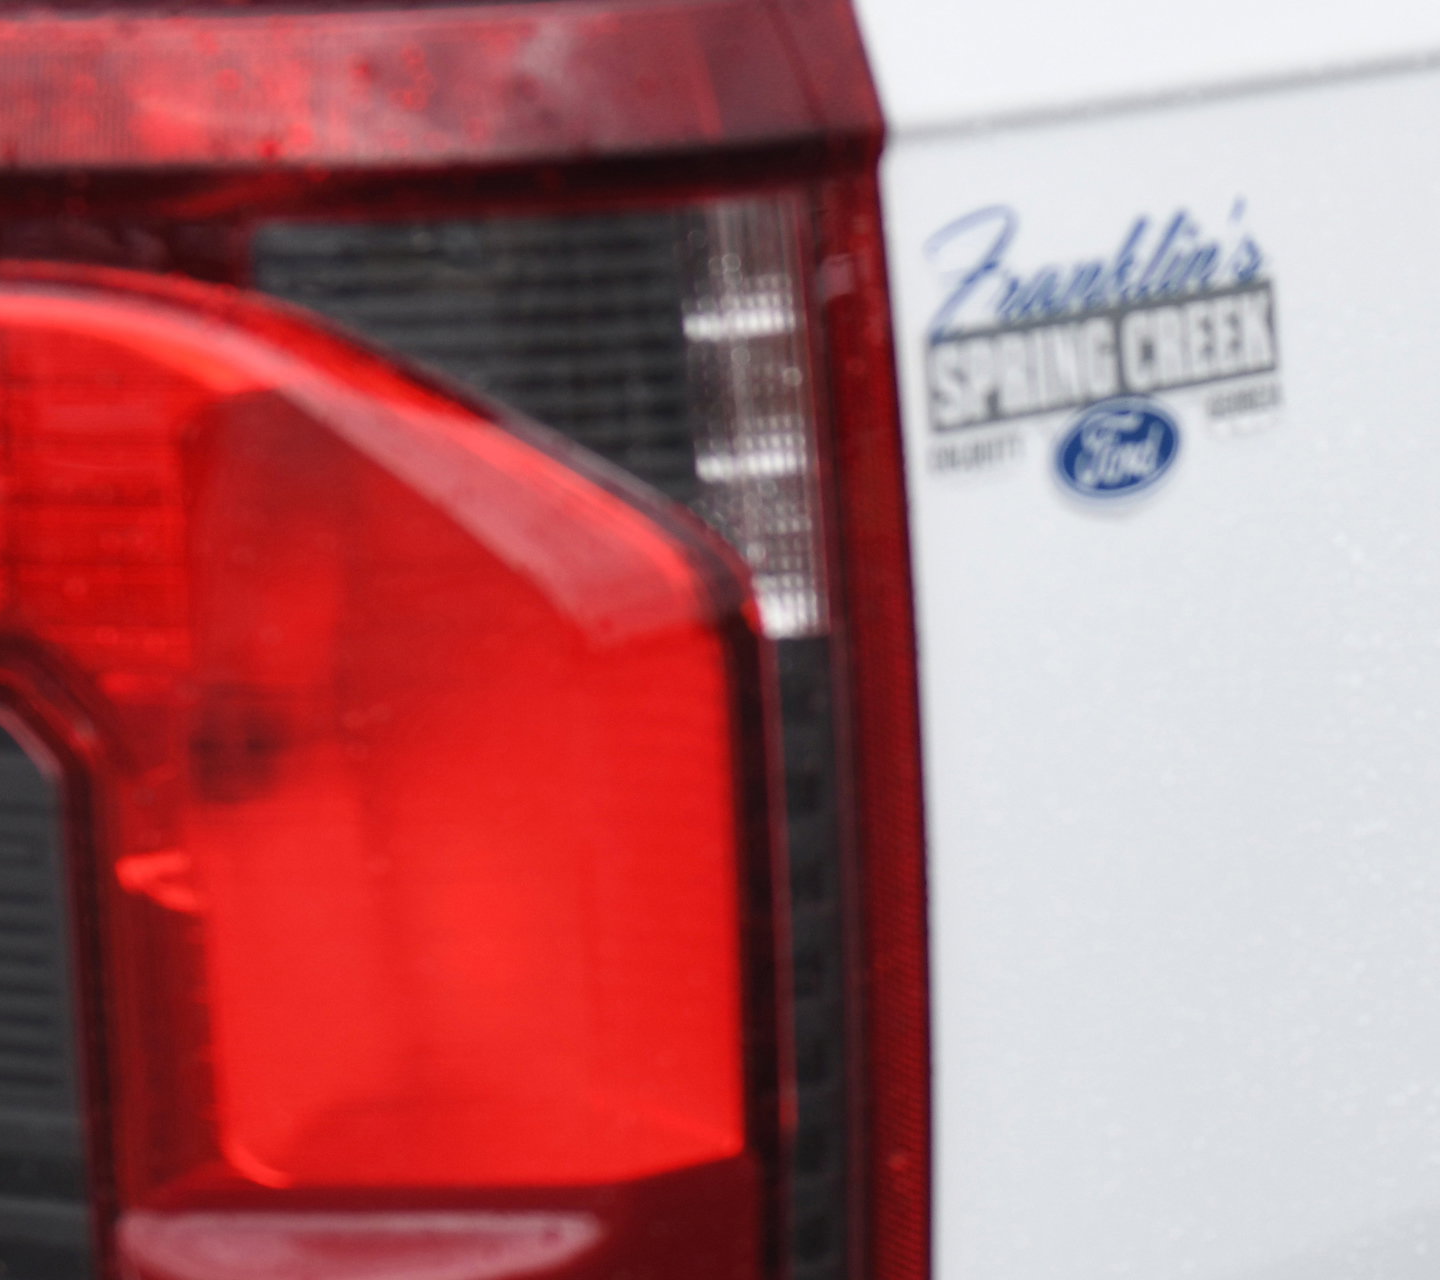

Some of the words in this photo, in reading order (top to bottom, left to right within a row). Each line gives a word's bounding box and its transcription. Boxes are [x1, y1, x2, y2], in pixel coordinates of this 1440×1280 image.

[923, 195, 1263, 345] Franklin's
[930, 316, 1118, 431] SPRING
[1122, 285, 1275, 393] CREEK
[1073, 409, 1166, 490] Ford
